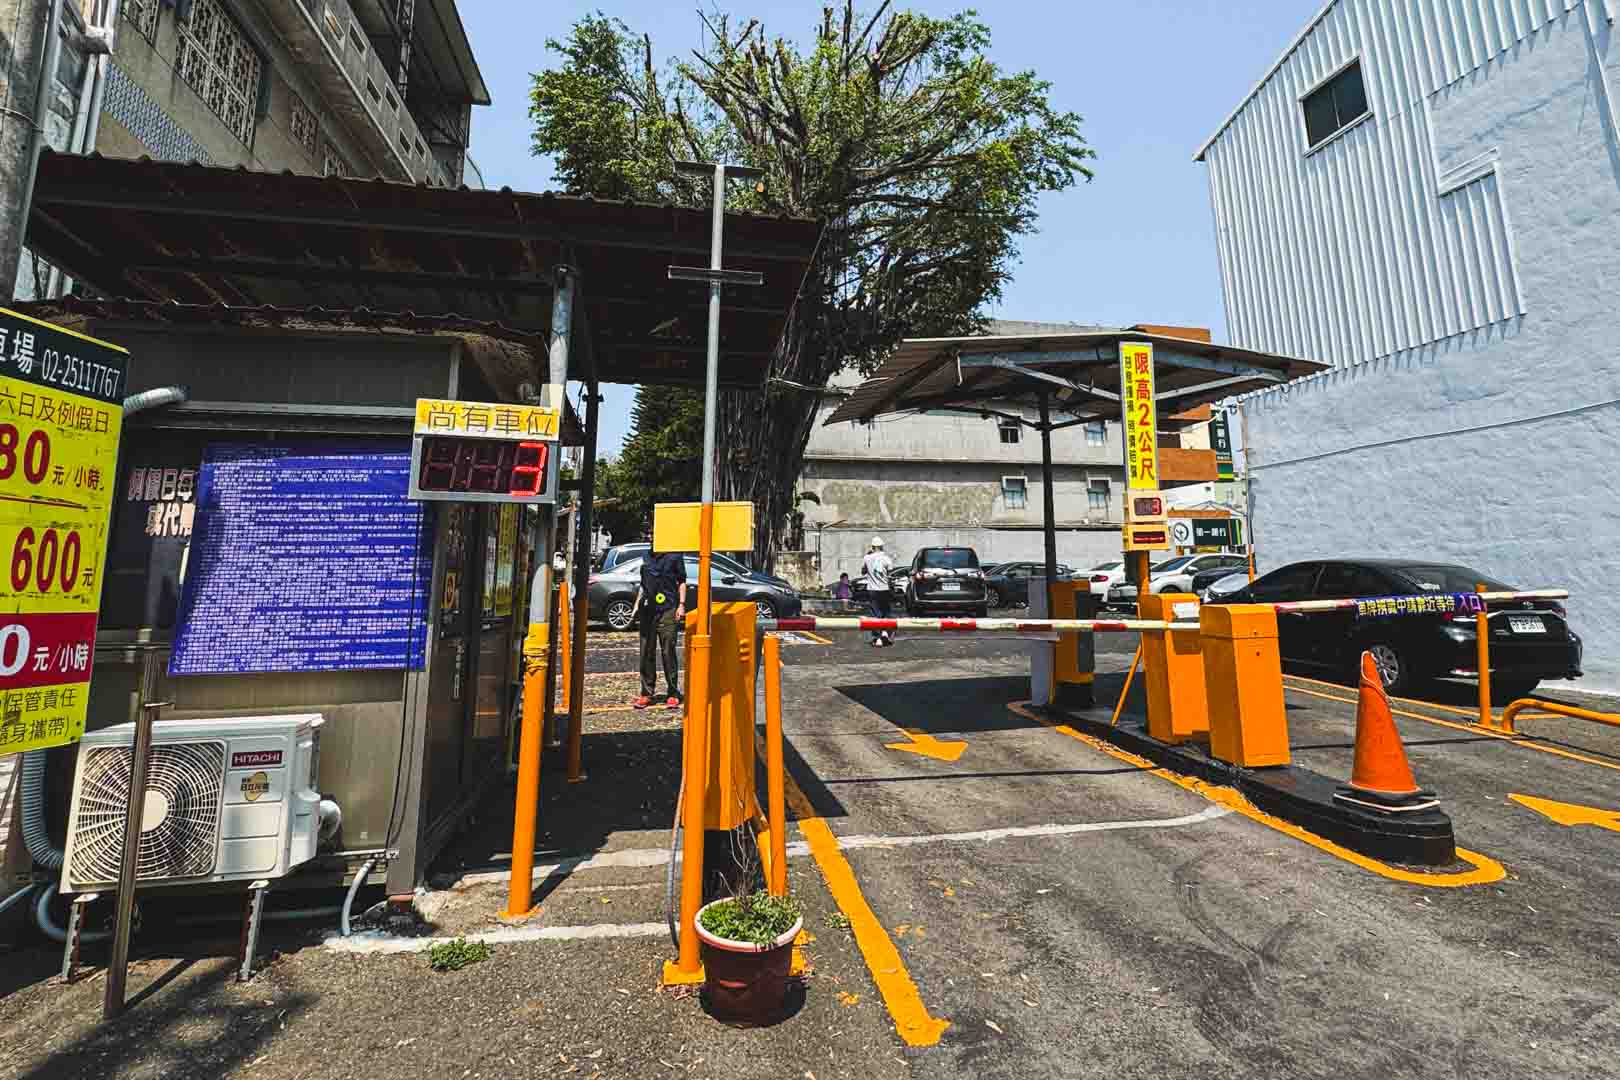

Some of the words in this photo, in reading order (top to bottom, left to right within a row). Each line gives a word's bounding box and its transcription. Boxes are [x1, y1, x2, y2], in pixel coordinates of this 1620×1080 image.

[41, 349, 121, 398] 02-25117767
[428, 403, 553, 436] 尚有車位
[1134, 352, 1155, 480] 限高2公尺
[511, 442, 547, 496] 3
[10, 526, 81, 593] 600
[33, 642, 89, 672] 元/小時
[234, 753, 280, 764] HITACHI
